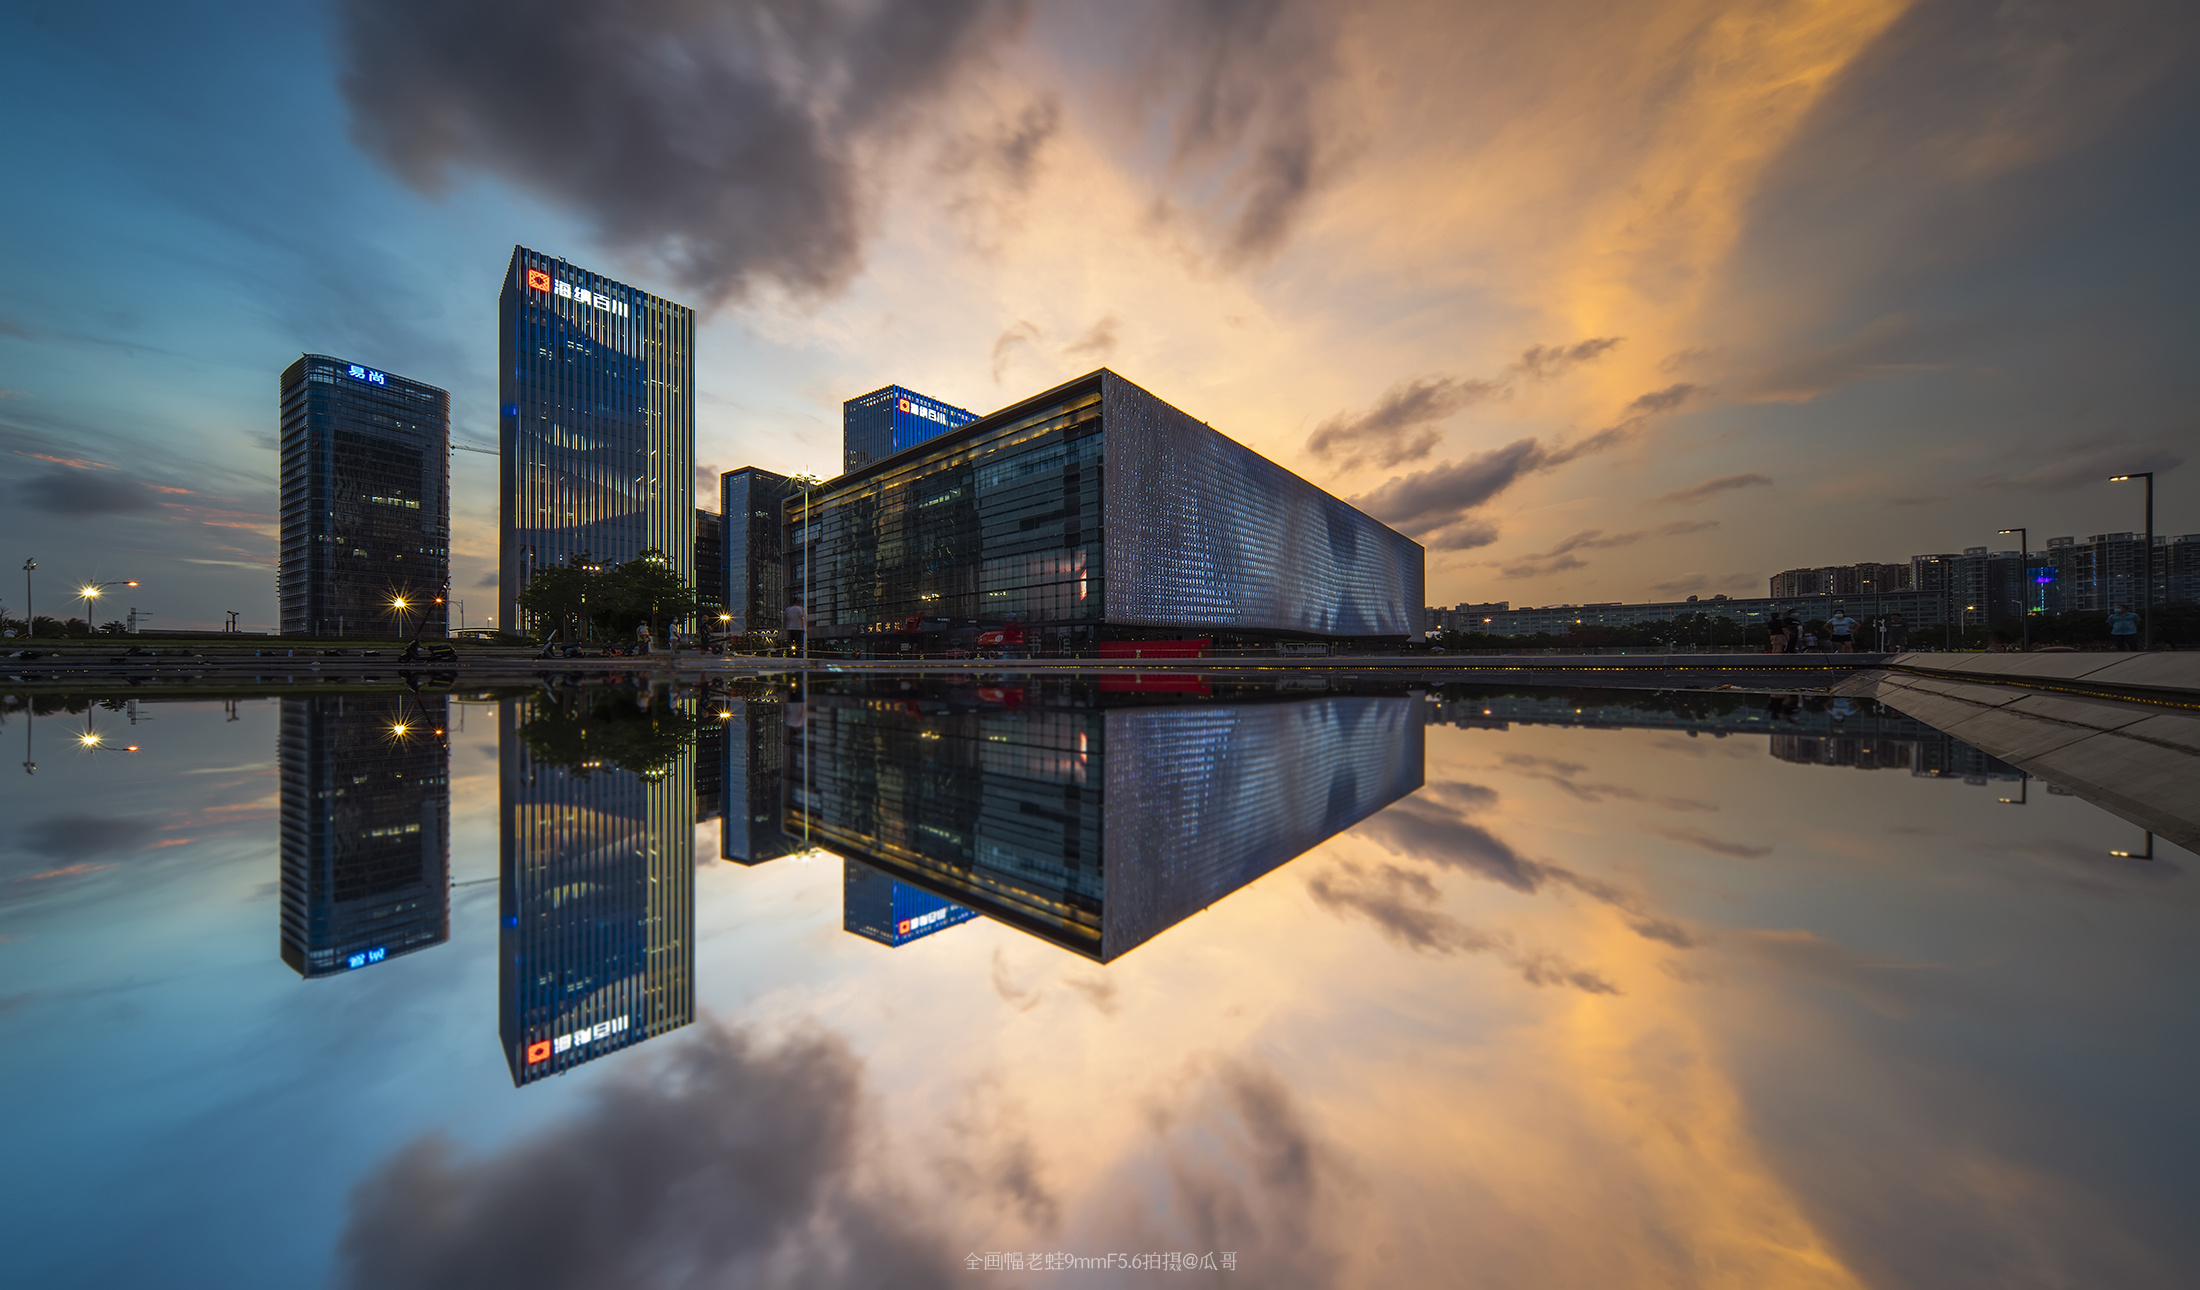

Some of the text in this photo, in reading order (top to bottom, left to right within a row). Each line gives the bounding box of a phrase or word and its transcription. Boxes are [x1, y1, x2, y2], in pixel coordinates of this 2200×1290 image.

[553, 278, 629, 318] 海纳百川
[348, 364, 385, 385] 易尚
